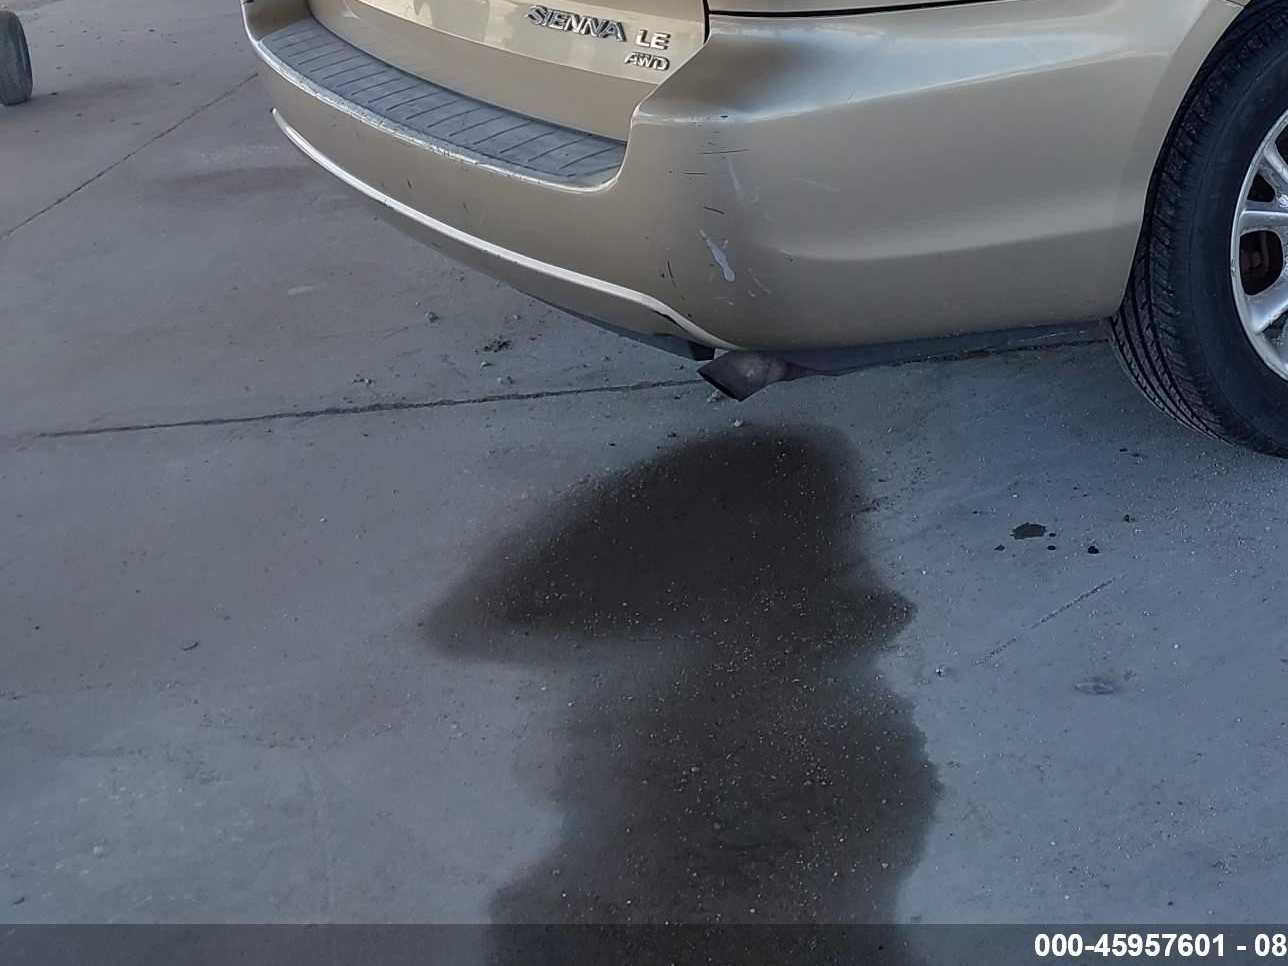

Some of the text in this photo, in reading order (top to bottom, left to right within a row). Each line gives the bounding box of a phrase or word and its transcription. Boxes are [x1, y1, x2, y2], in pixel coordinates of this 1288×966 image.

[525, 4, 671, 50] SIENNA LE
[624, 51, 671, 71] AWD
